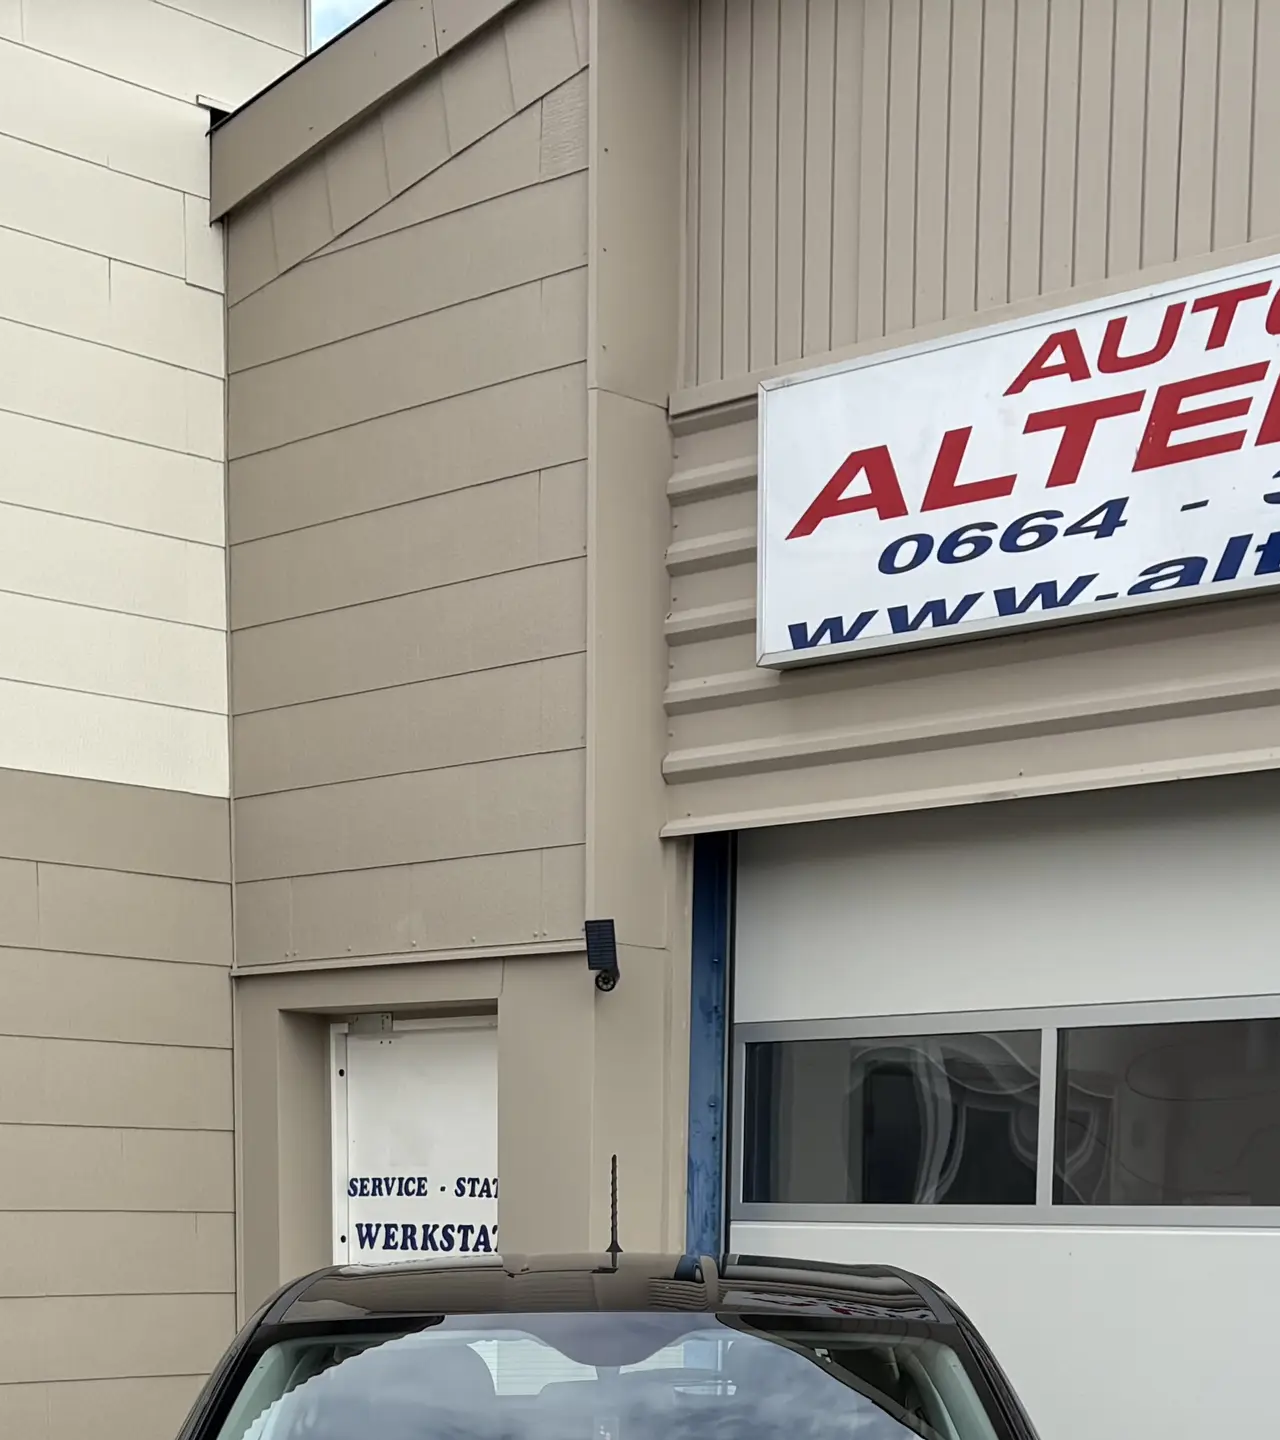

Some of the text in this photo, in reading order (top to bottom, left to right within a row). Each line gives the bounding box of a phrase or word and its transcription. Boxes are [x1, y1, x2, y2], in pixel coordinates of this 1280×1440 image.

[877, 496, 1130, 575] 0664
[1180, 499, 1210, 512] -
[347, 1176, 428, 1197] SERVICE
